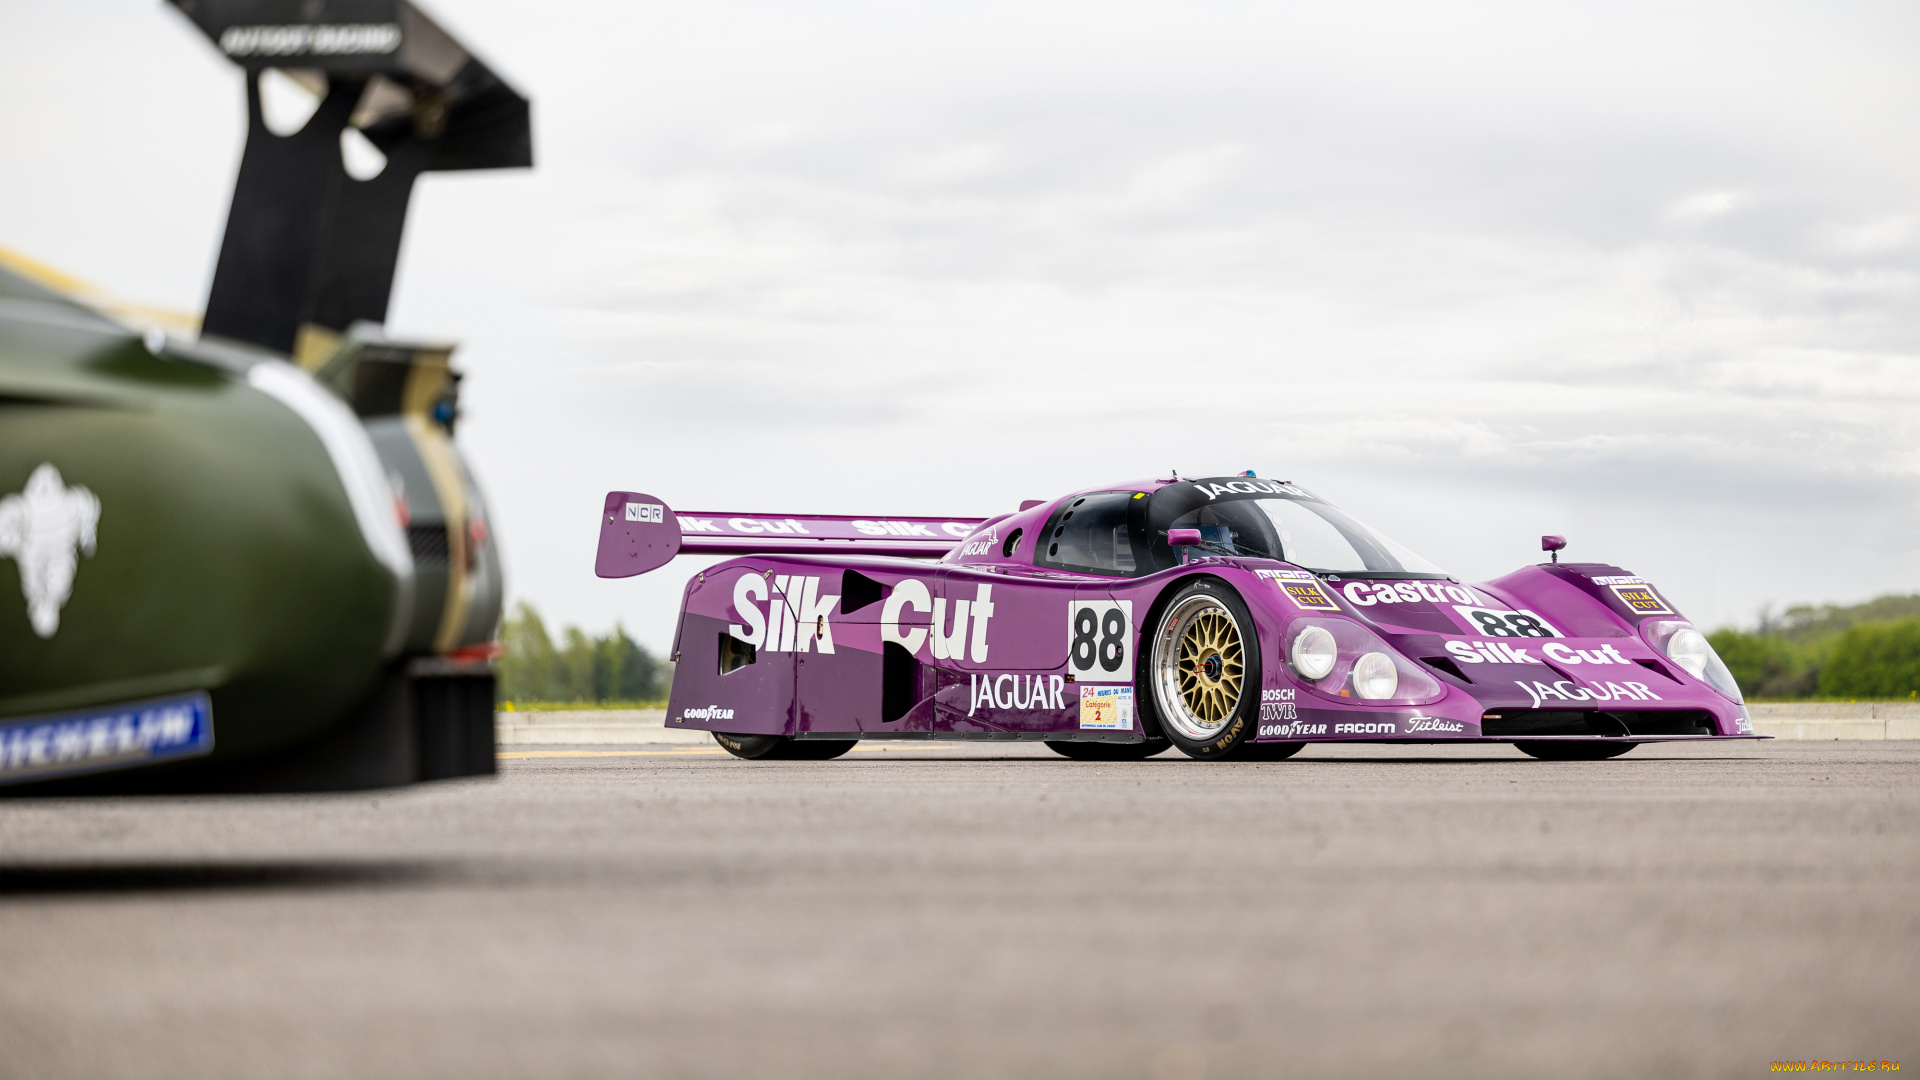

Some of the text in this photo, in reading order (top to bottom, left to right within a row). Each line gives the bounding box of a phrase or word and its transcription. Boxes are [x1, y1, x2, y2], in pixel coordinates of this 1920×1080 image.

[1193, 481, 1314, 500] JAGUAR
[628, 507, 661, 520] NCR
[728, 517, 810, 535] Cut
[851, 519, 939, 537] Silk
[957, 541, 992, 560] JAGUAR
[1286, 586, 1321, 596] SILK
[1297, 596, 1326, 605] CUT
[1342, 580, 1486, 607] Castrol
[1621, 591, 1654, 601] SILK
[1632, 600, 1660, 609] CUT
[728, 572, 995, 664] Silk Cut
[1471, 610, 1555, 638] 88
[1072, 607, 1126, 673] 88
[1444, 640, 1632, 665] Silk Cut
[967, 673, 1066, 718] JAGUAR
[1082, 687, 1095, 698] 24
[1097, 689, 1112, 697] HEURES
[1120, 686, 1132, 694] MANS
[1262, 688, 1295, 701] BOSCH
[1513, 680, 1664, 709] JAGUAR
[1095, 710, 1102, 721] 2
[1261, 703, 1297, 720] TWR
[1216, 715, 1245, 750] AVON
[1334, 723, 1396, 734] FACOM
[1404, 716, 1464, 734] Titleist
